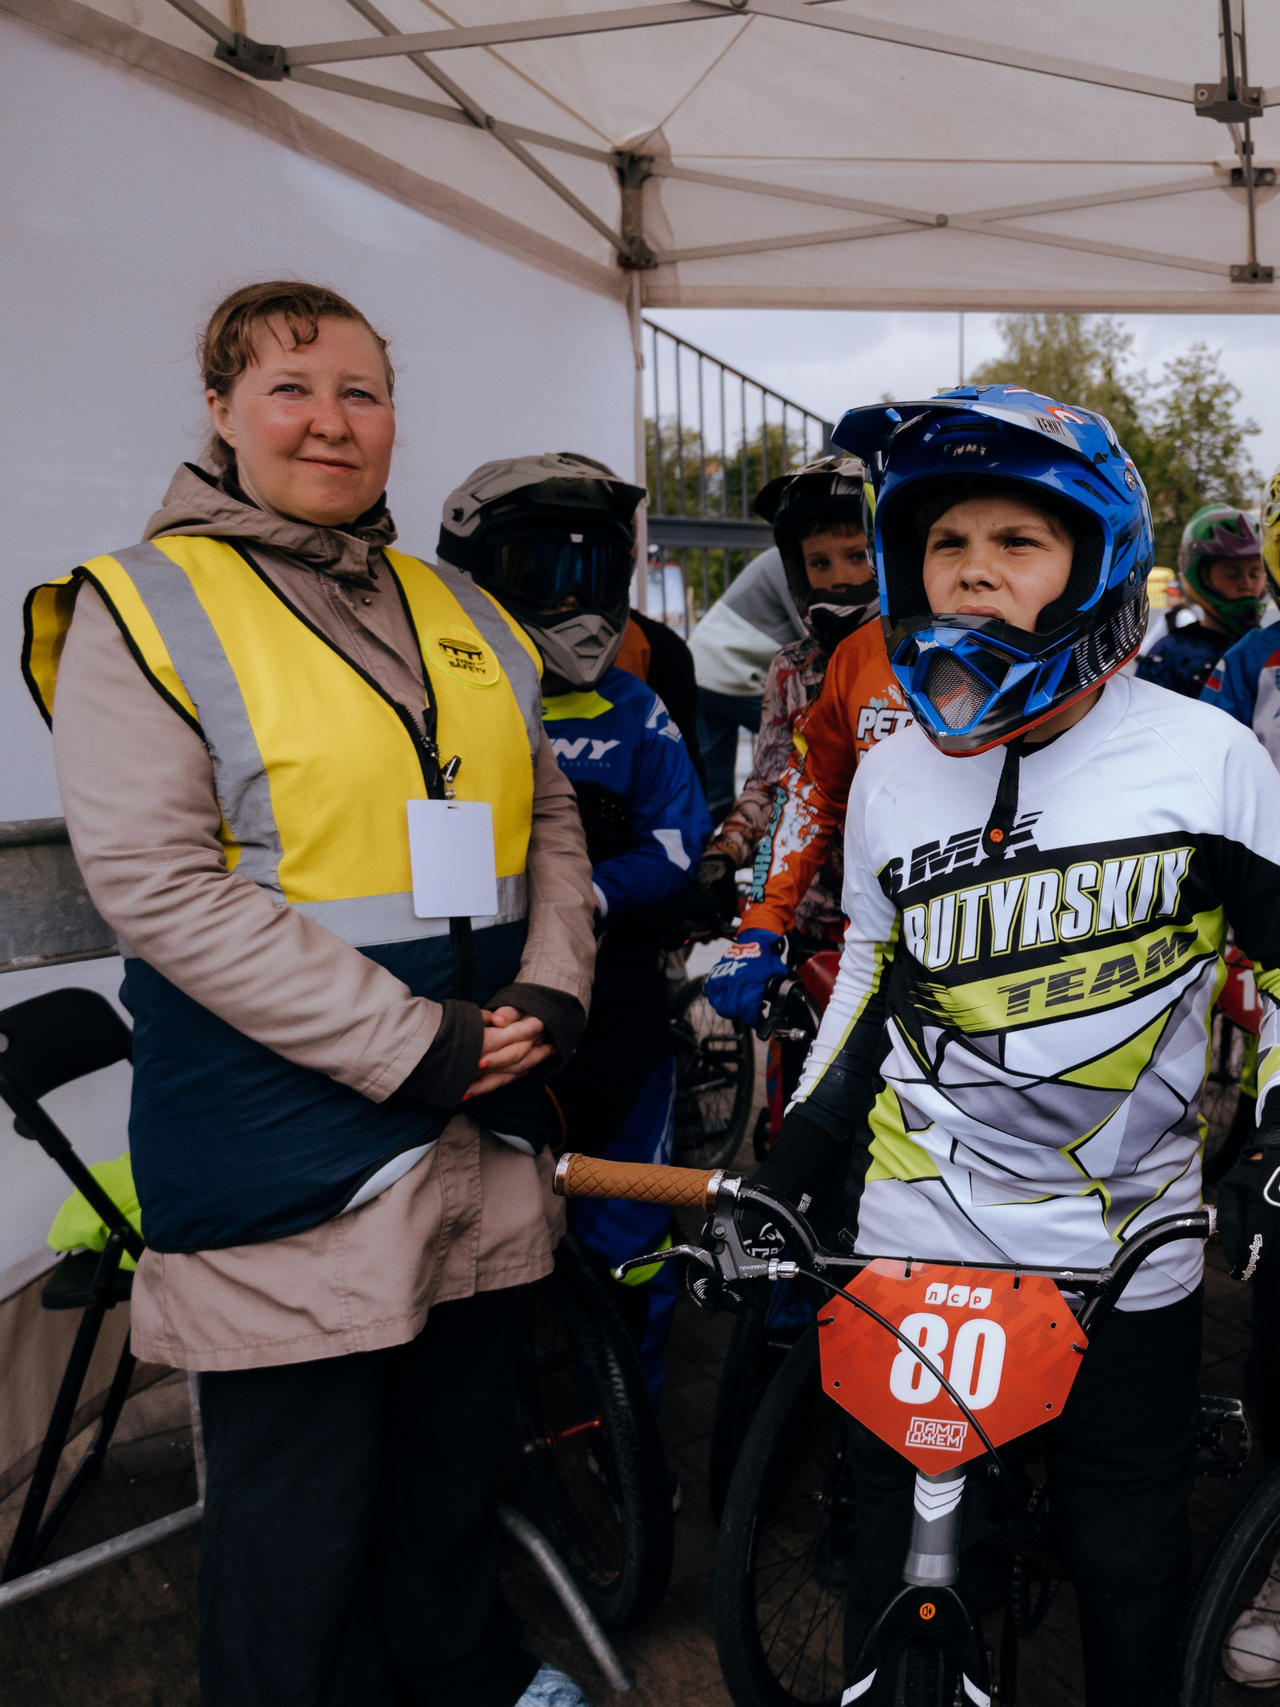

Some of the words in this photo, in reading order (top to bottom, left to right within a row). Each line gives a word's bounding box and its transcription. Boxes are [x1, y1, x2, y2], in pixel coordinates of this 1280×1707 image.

[1034, 416, 1066, 437] KENNY
[449, 660, 487, 675] SAFETY
[902, 848, 1196, 971] BUTYRSKIY
[998, 927, 1198, 1017] TEAM
[926, 1287, 987, 1308] ЛСР
[890, 1312, 1006, 1411] 80
[910, 1431, 961, 1447] ДЖЕМ
[913, 1421, 965, 1437] ПАМП
